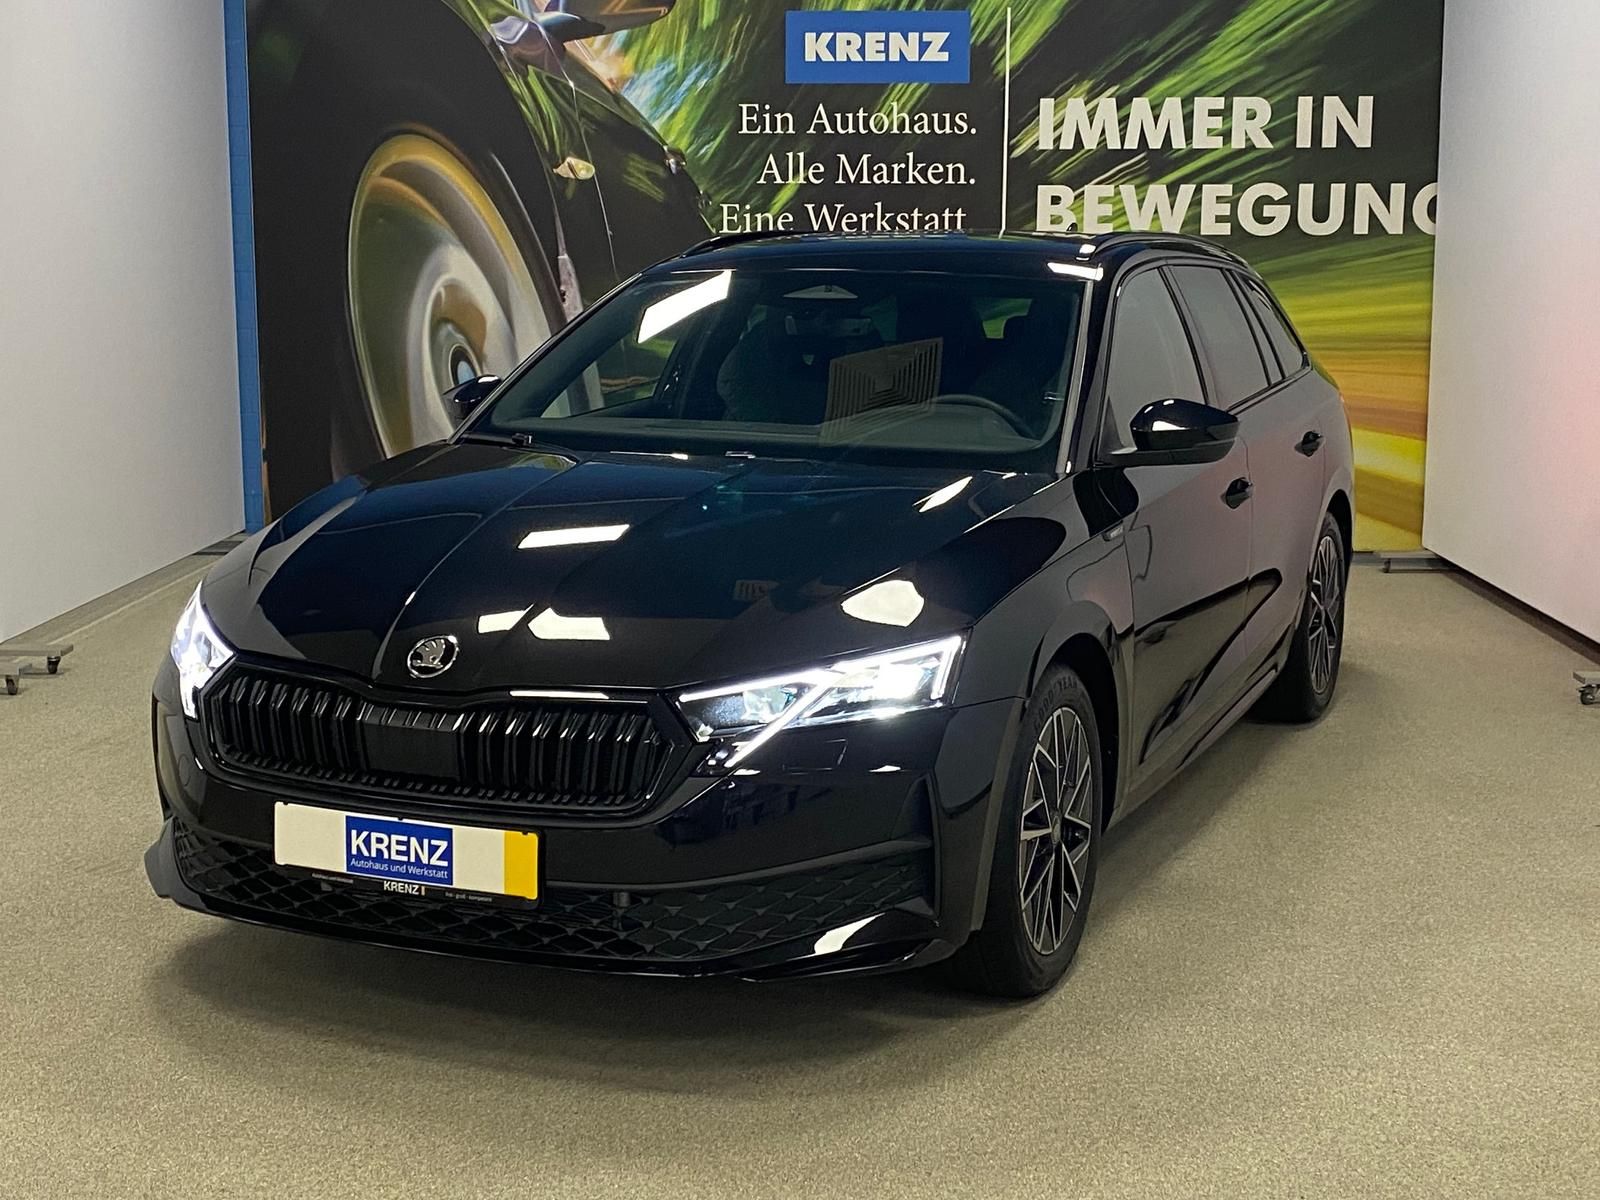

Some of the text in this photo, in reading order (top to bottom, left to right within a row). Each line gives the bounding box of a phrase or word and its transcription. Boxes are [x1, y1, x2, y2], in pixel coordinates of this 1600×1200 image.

[804, 32, 950, 62] KRENZ
[738, 101, 977, 135] Ein Autohaus.
[1038, 95, 1374, 150] IMMER IN
[756, 151, 976, 185] Alle Marken.
[719, 201, 967, 234] Eine Werkstatt
[351, 829, 449, 867] KRENZ
[350, 857, 448, 879] Autohaus und Werkstatt
[383, 880, 420, 895] KRENZ
